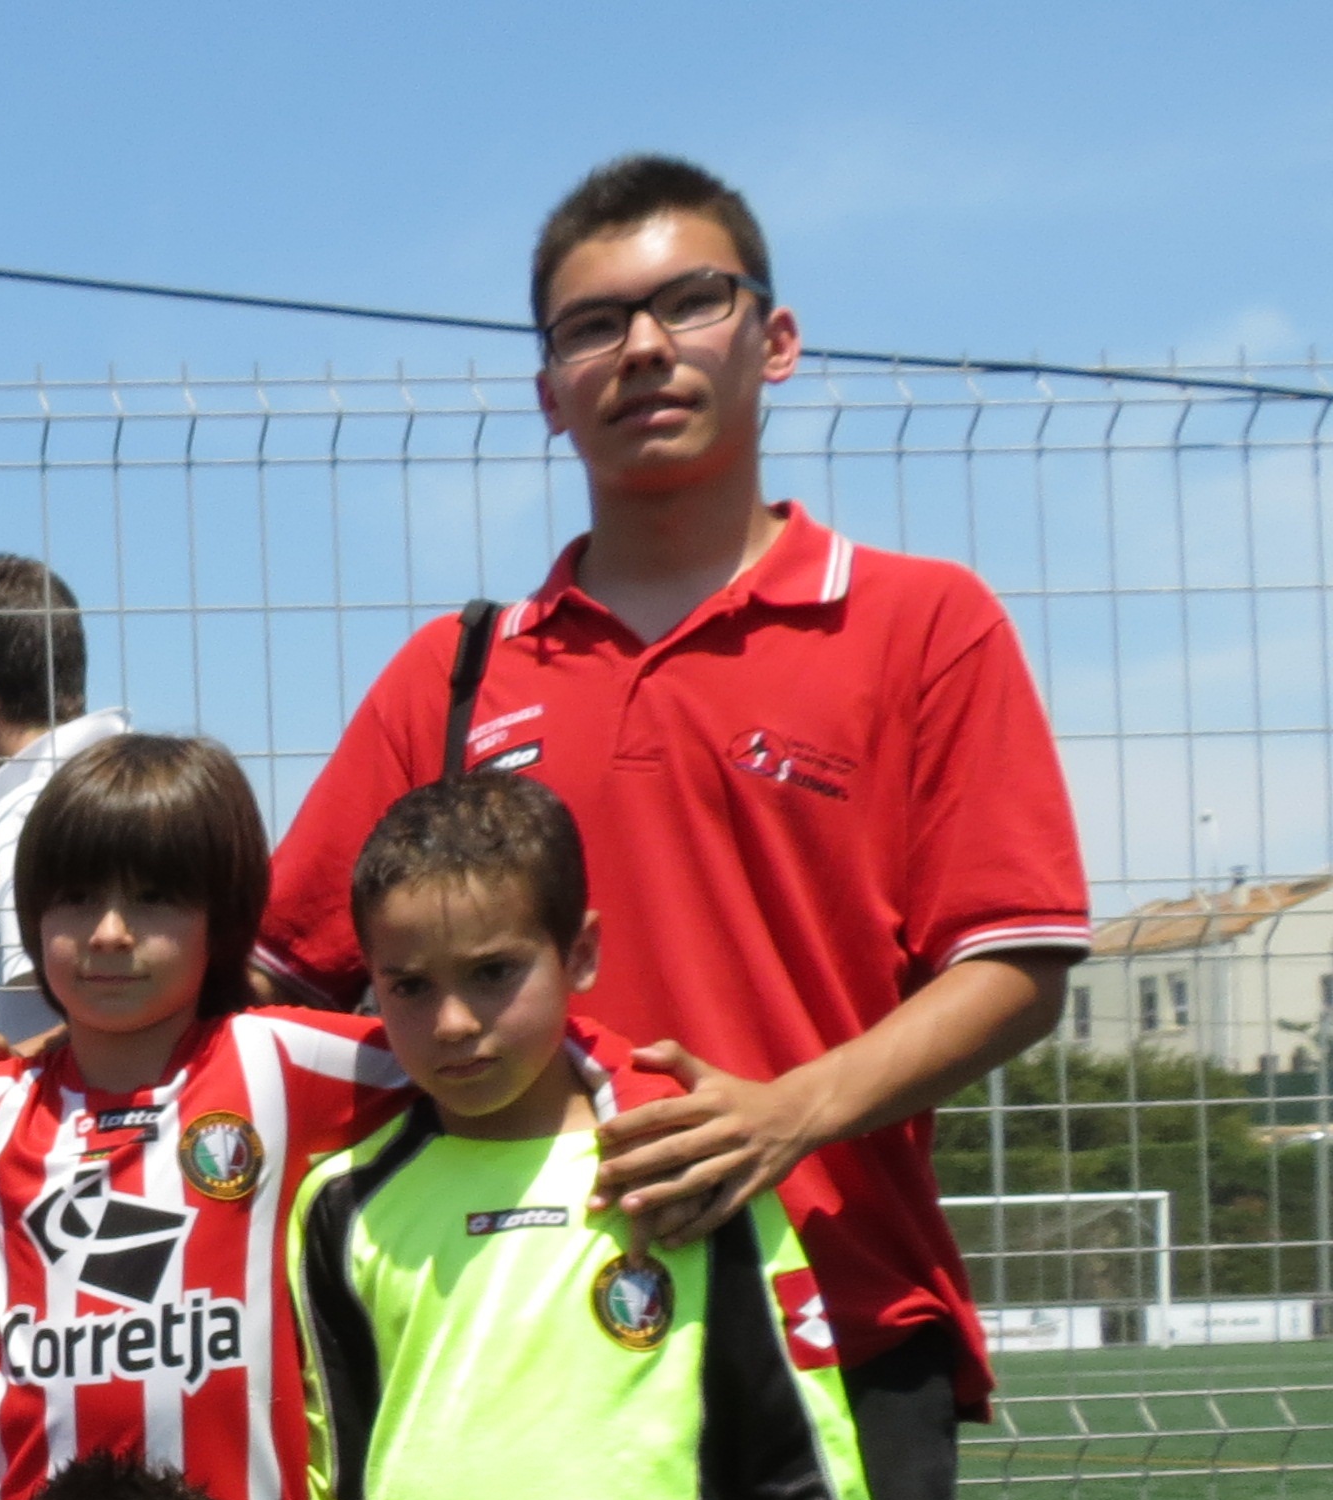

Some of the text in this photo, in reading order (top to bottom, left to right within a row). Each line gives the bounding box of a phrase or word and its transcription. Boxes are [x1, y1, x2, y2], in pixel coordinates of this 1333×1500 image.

[98, 1110, 161, 1130] lotto
[496, 1208, 569, 1229] lotto
[2, 1297, 242, 1386] Corretja
